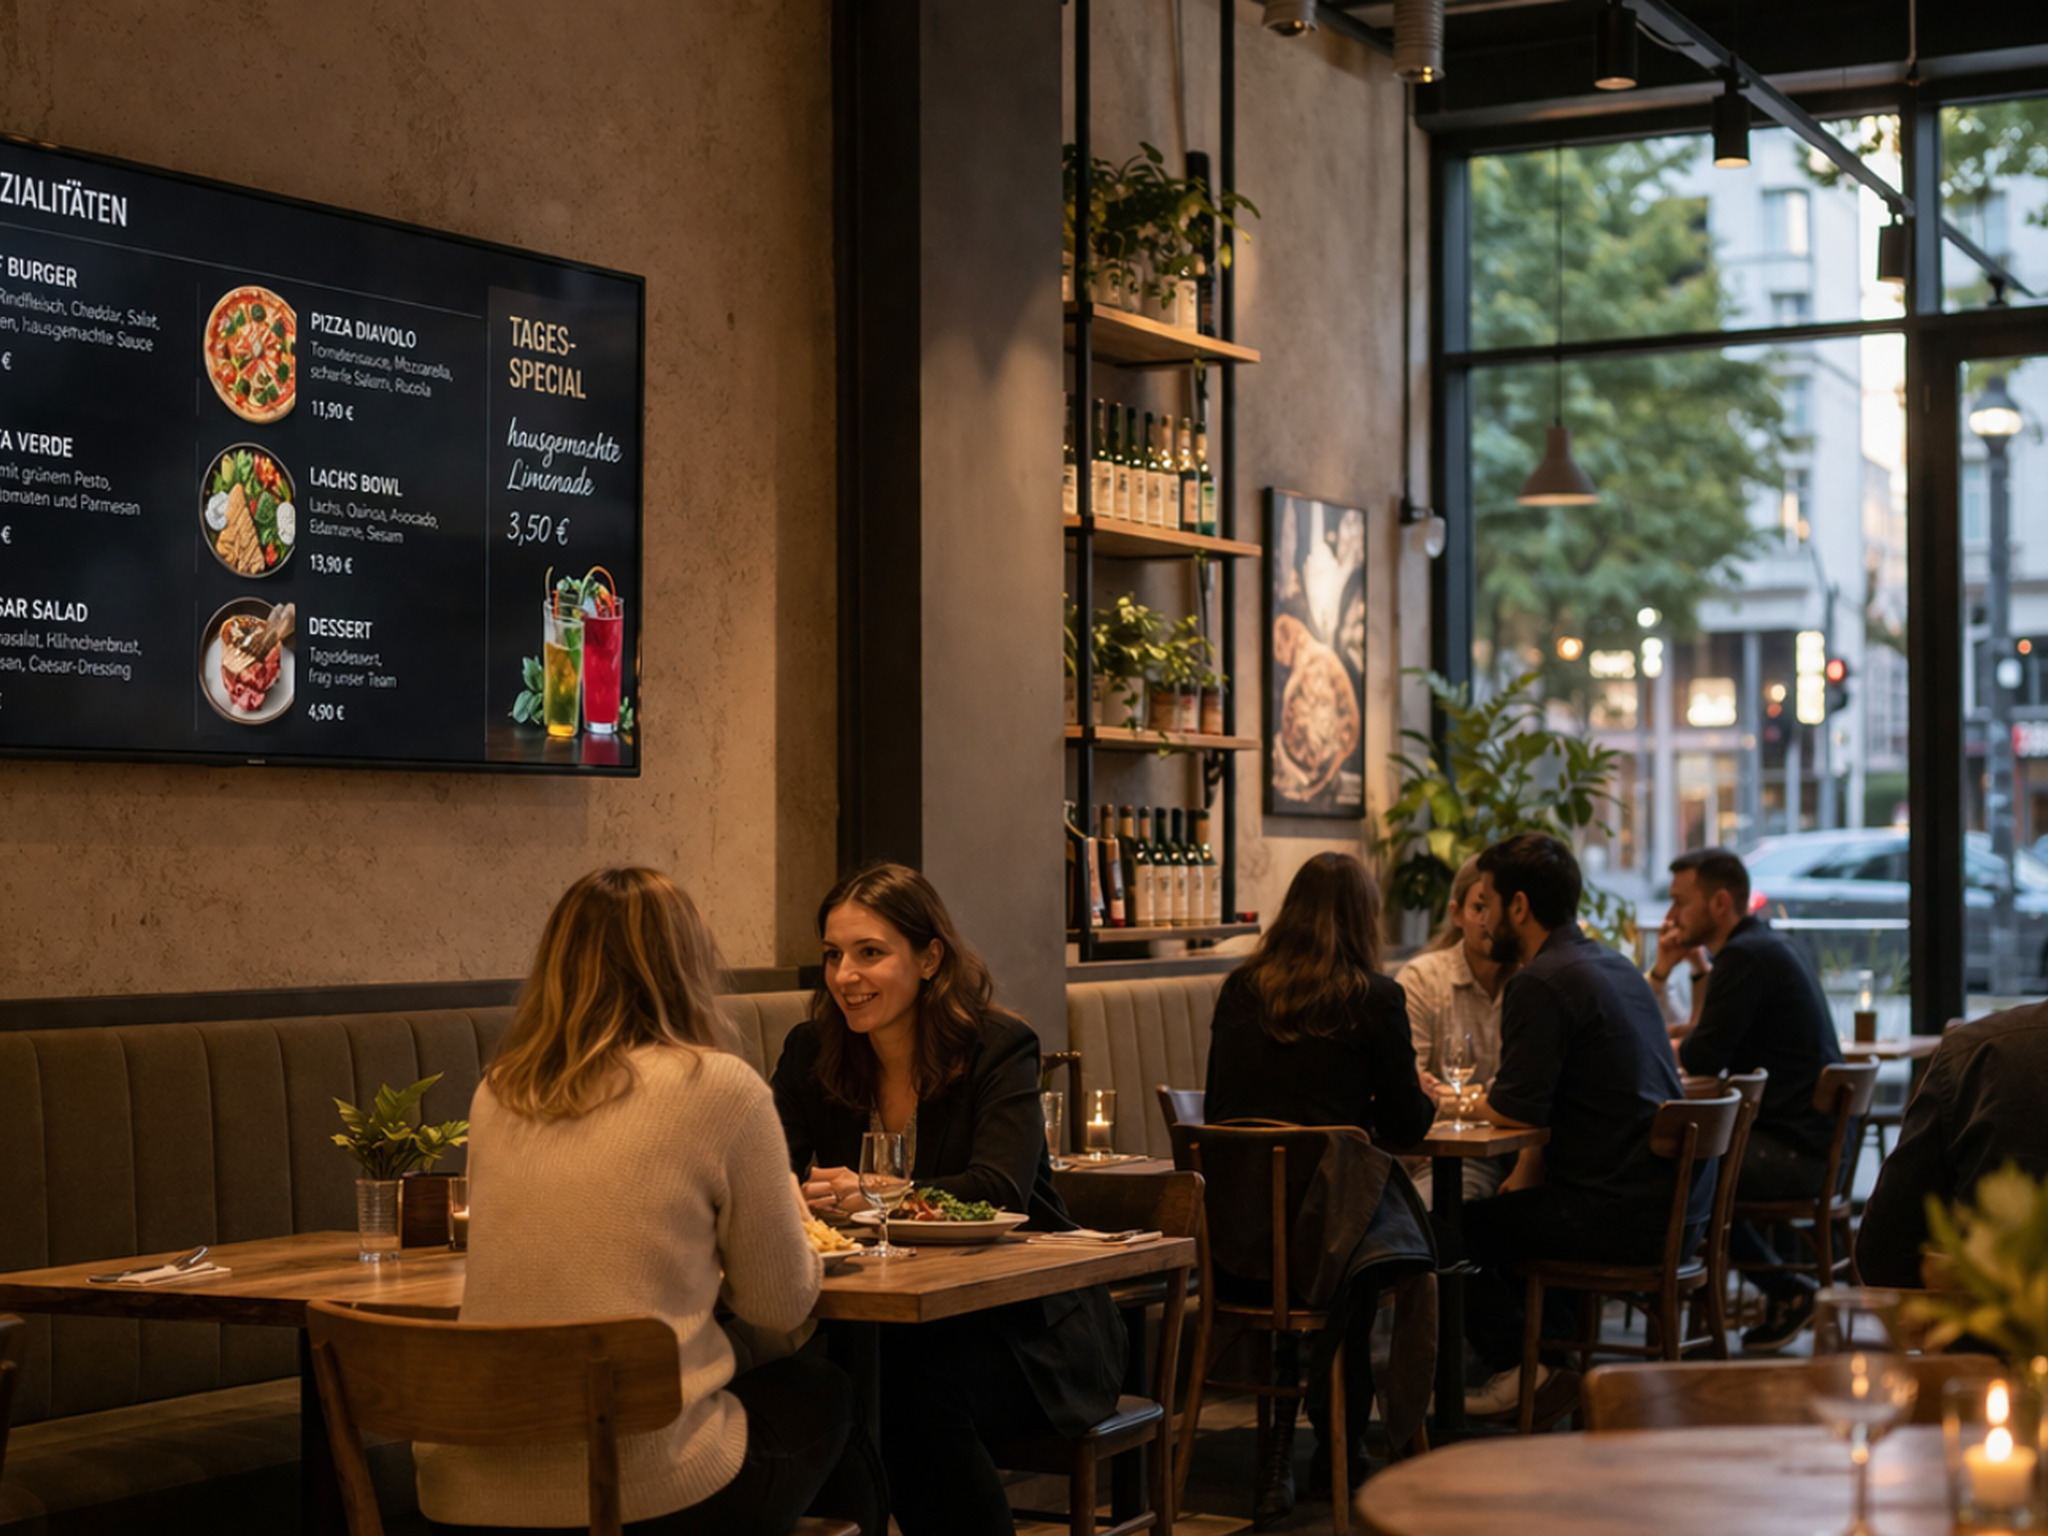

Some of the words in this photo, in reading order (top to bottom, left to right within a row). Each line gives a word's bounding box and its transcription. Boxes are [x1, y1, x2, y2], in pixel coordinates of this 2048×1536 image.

[7, 256, 78, 289] BURGER
[116, 331, 155, 352] Sauce
[310, 311, 353, 338] PIZZA
[355, 320, 418, 350] DIAVOLO
[509, 315, 577, 357] TAGES-
[1, 351, 13, 371] €
[509, 357, 587, 400] SPECIAL
[311, 399, 344, 420] 11,90
[344, 405, 355, 421] €
[17, 430, 74, 459] VERDE
[506, 416, 623, 468] hausgemachte
[73, 470, 112, 492] Pesto,
[309, 466, 358, 491] LACHS
[360, 474, 404, 498] BOWL
[506, 457, 596, 497] Limonade
[53, 492, 78, 510] und
[80, 493, 141, 516] Parmesan
[1, 525, 12, 545] €
[506, 510, 552, 547] 3,50
[555, 517, 571, 547] €
[310, 553, 342, 575] 13,90
[343, 556, 354, 575] €
[32, 599, 89, 622] SALAD
[308, 616, 373, 640] DESSERT
[28, 653, 133, 682] Caesar-Dressing
[307, 703, 334, 722] 4,90
[335, 704, 345, 721] €
